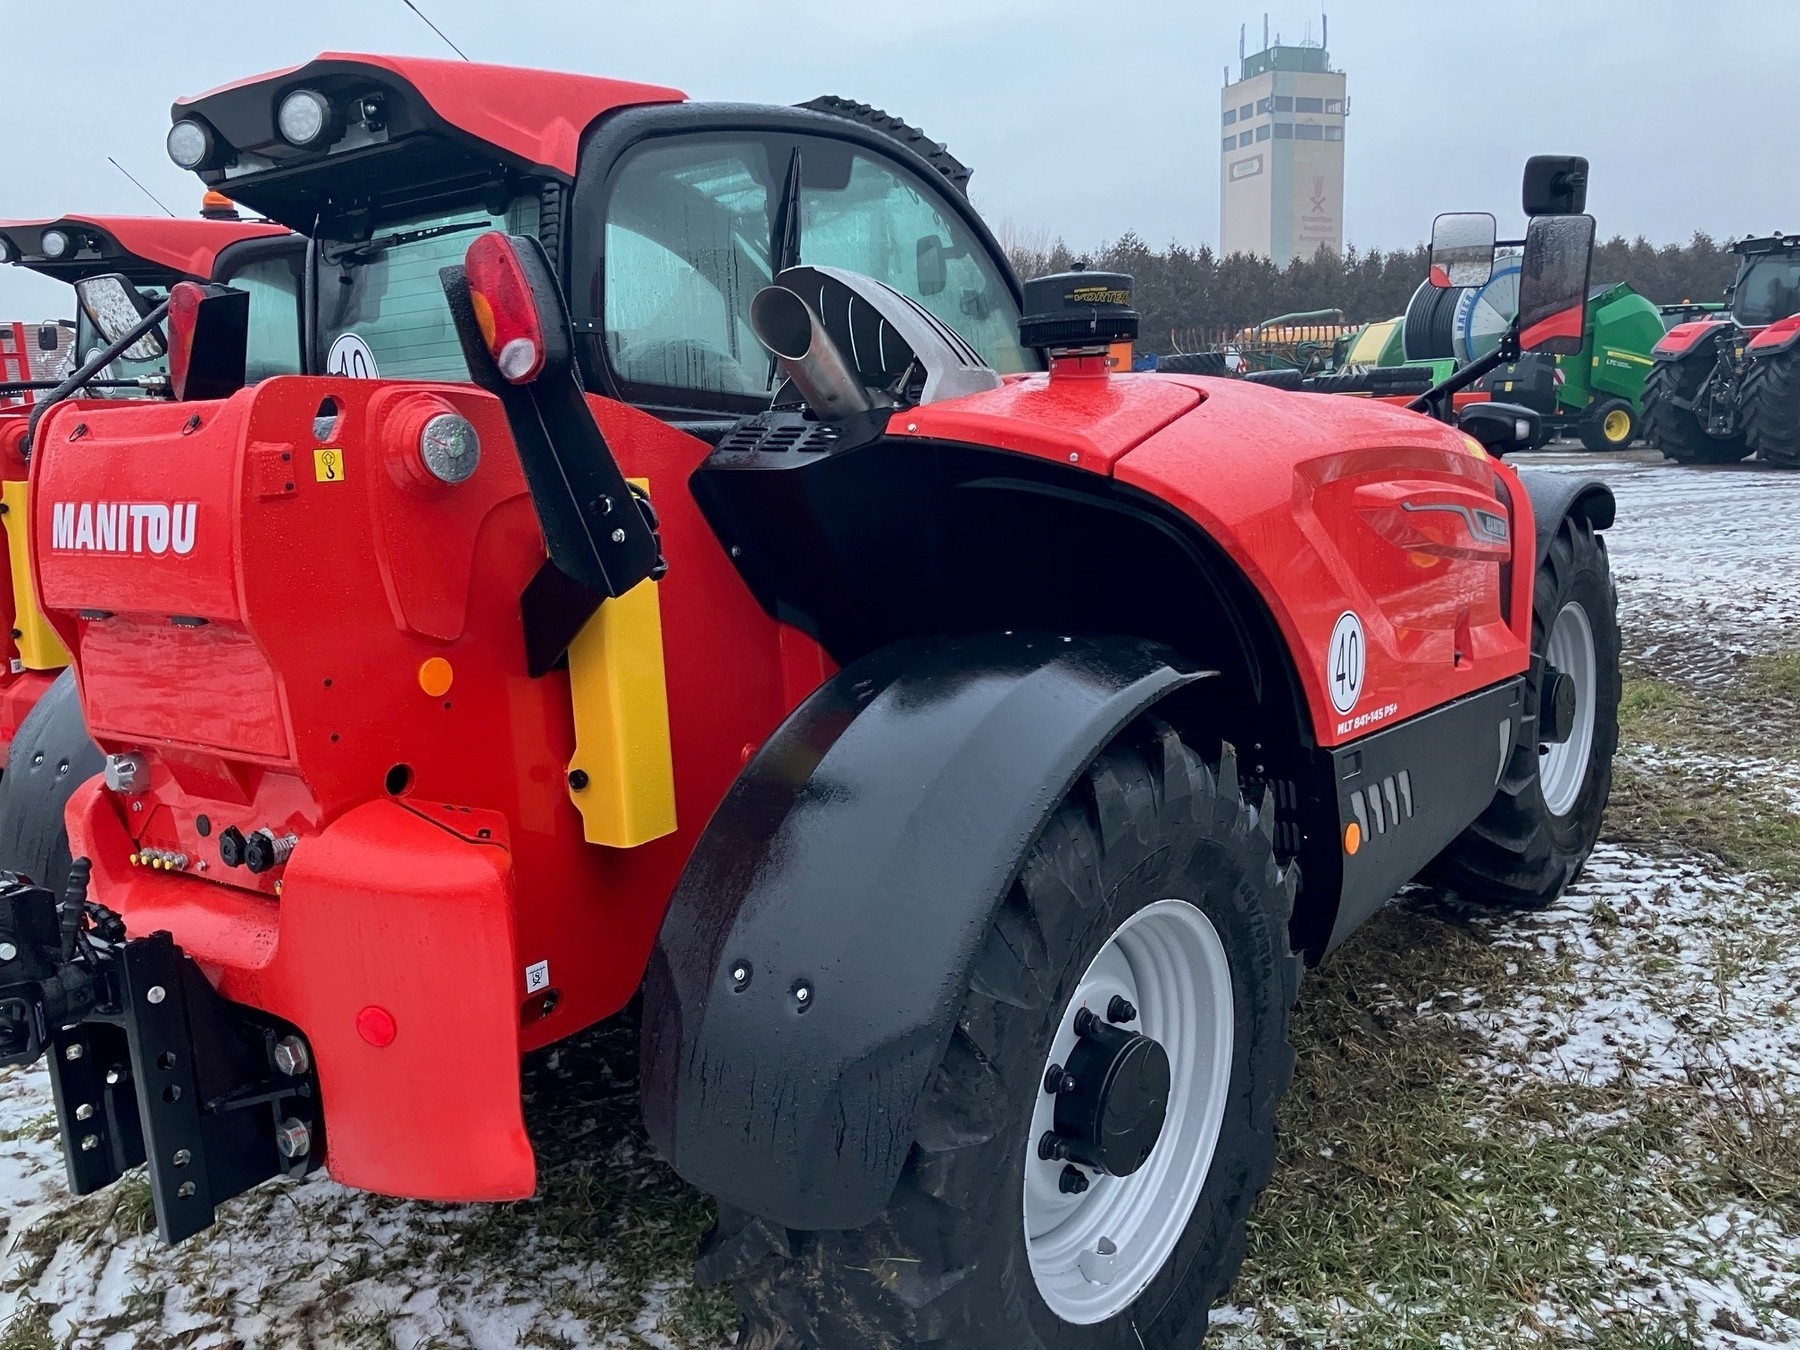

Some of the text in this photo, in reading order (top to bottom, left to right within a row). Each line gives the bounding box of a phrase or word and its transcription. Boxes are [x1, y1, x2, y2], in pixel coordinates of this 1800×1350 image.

[1457, 294, 1473, 332] BAUER
[52, 503, 197, 554] MANITOU
[1336, 630, 1358, 695] 40
[1336, 702, 1399, 736] MLT 841-145 PS+
